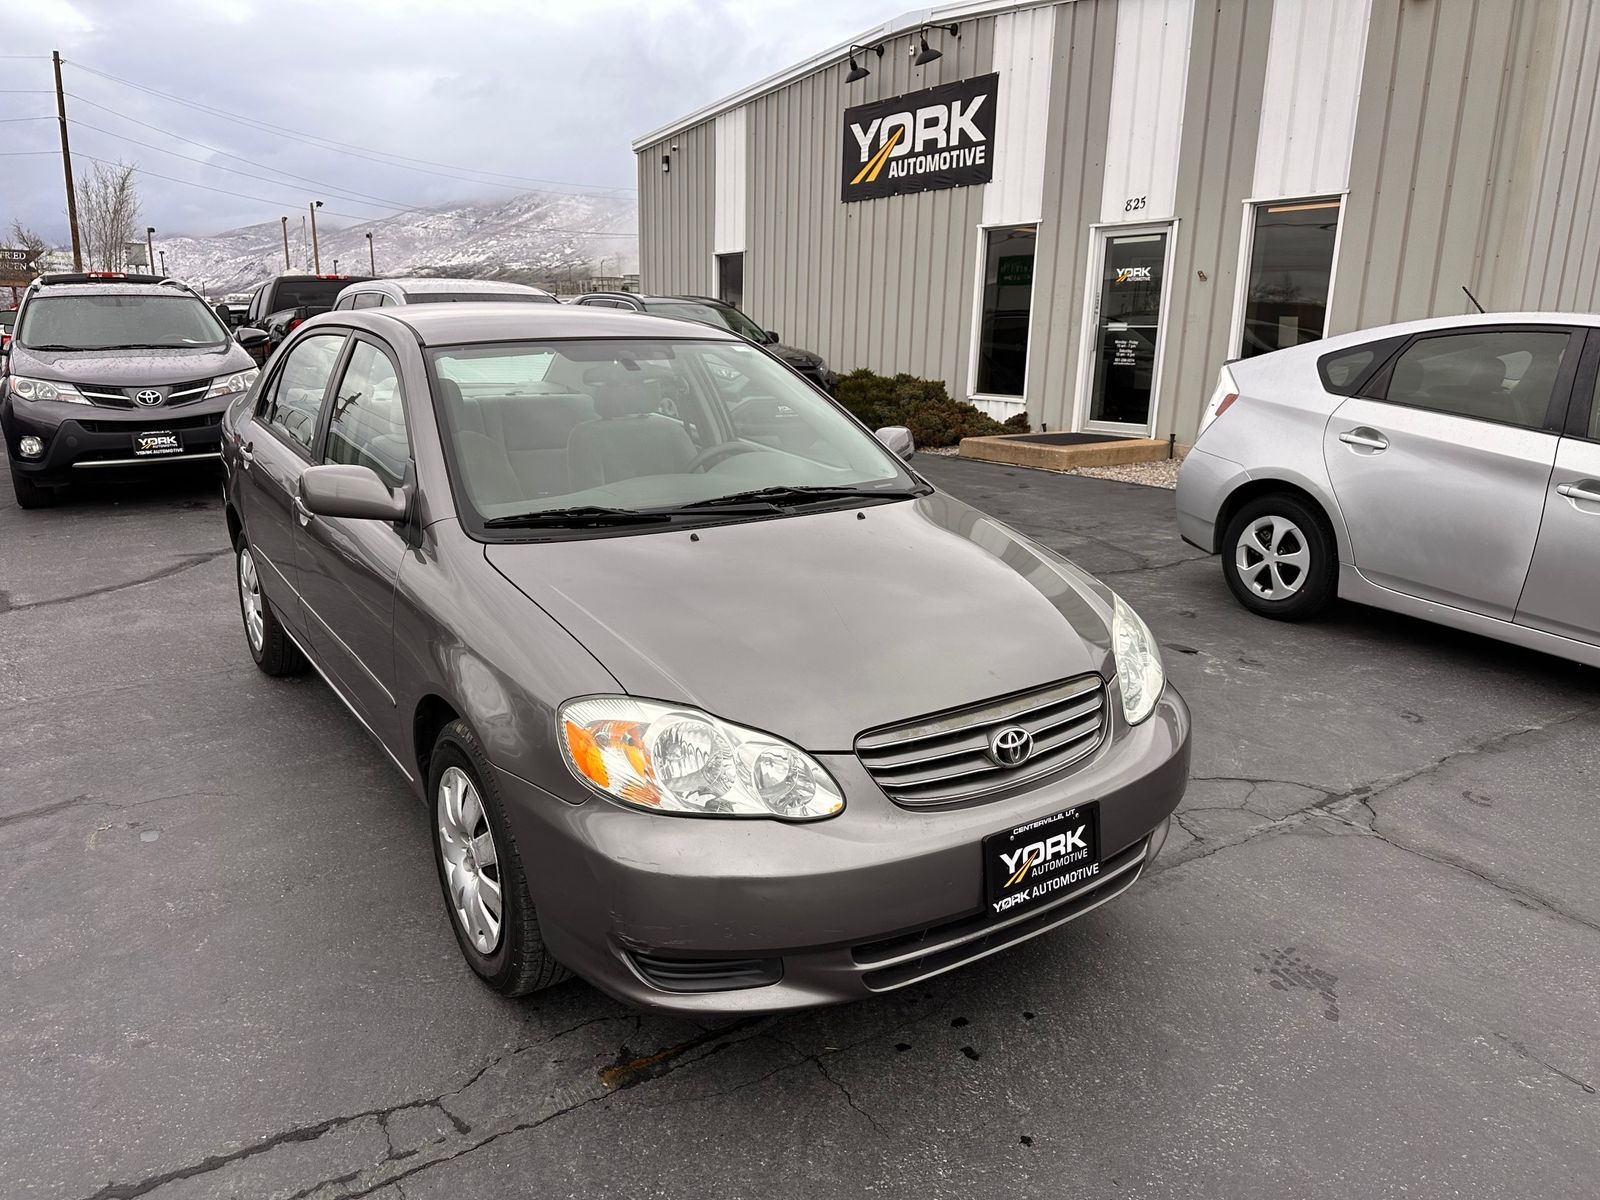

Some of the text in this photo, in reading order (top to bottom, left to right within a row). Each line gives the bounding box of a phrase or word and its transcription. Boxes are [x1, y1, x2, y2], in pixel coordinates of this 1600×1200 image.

[850, 94, 987, 162] YORK
[888, 145, 985, 179] AUTOMOTIVE
[1125, 195, 1147, 212] 825
[1116, 267, 1151, 277] YORK
[138, 435, 178, 446] YORK
[1065, 808, 1076, 817] UT
[1000, 824, 1088, 875] YORK
[1031, 848, 1088, 878] AUTOMOTIVE
[993, 863, 1099, 912] YORK AUTOMOTIVE
